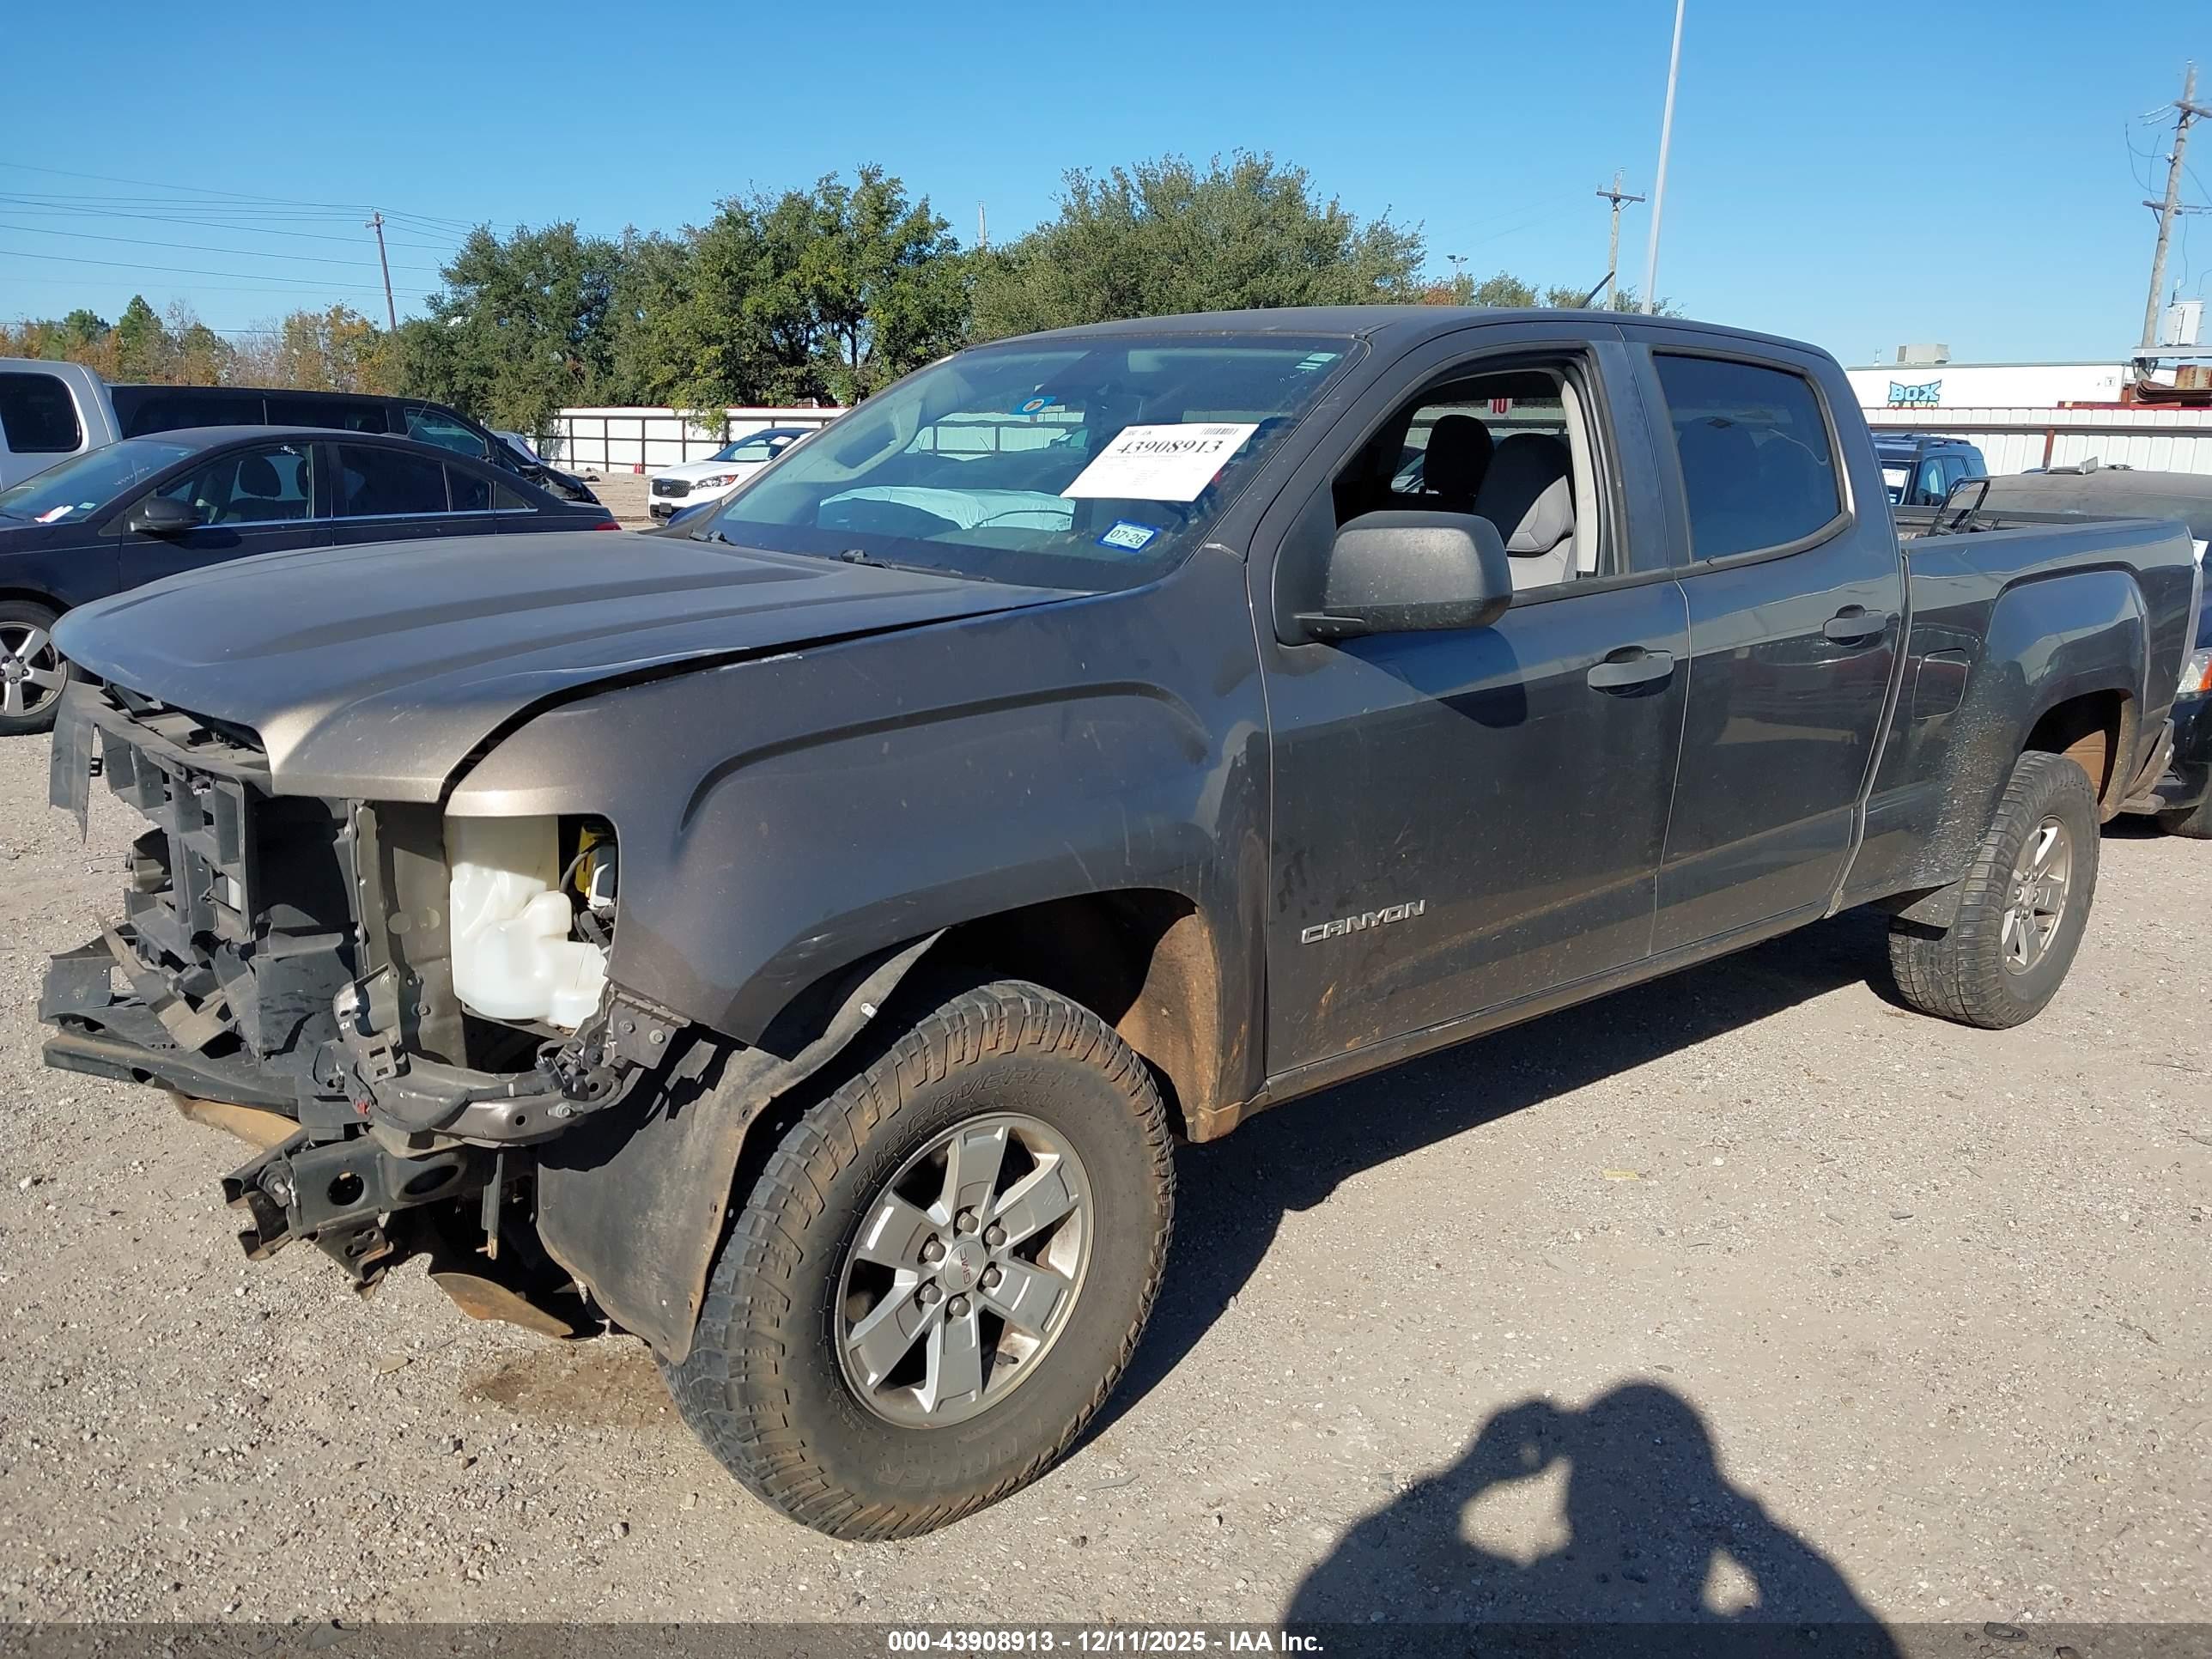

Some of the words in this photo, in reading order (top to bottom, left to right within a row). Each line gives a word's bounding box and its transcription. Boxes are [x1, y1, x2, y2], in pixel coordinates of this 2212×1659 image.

[1888, 380, 1942, 402] BOX
[1117, 440, 1224, 454] 43908913
[1110, 529, 1127, 539] 07
[1128, 532, 1146, 544] 26
[1301, 899, 1425, 944] CANYON
[959, 1247, 971, 1285] GMC
